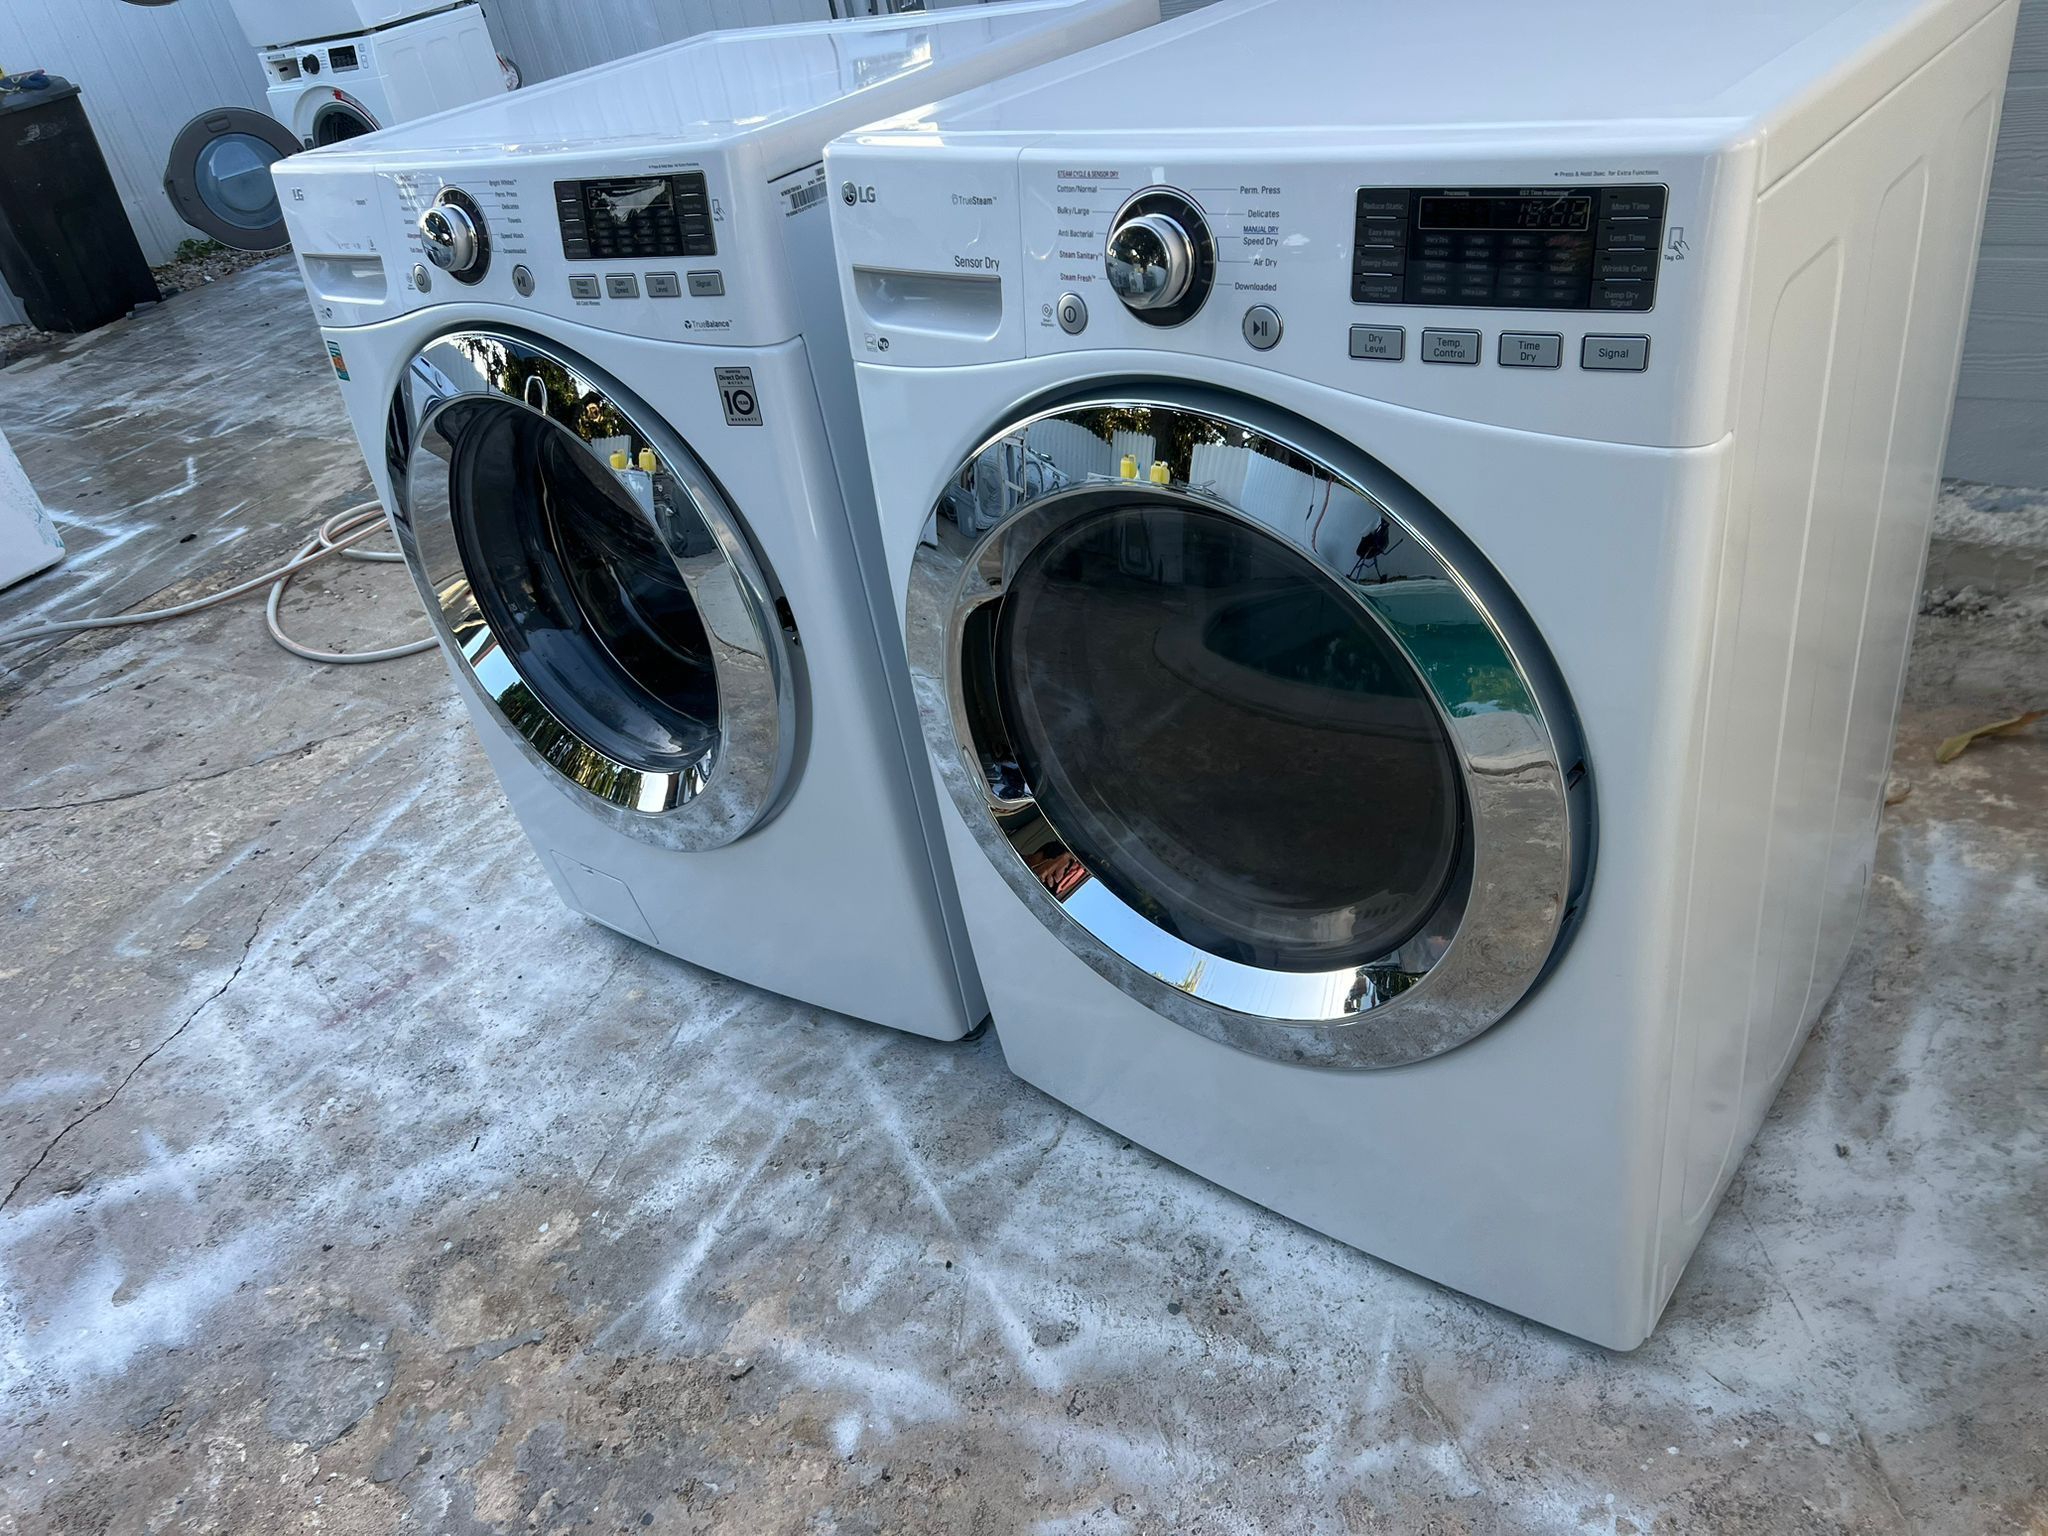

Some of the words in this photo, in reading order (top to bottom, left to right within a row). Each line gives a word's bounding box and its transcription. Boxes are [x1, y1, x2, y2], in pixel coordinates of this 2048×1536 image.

[1057, 185, 1098, 193] Cotton/Normal
[1240, 186, 1259, 194] Perm.
[1261, 186, 1281, 194] Press
[858, 186, 876, 203] LG
[1057, 207, 1090, 216] Bulky/Large
[1248, 209, 1280, 218] Delicates
[1058, 230, 1070, 238] Anti
[1070, 230, 1094, 238] Bacterial
[1244, 225, 1266, 233] MANUAL
[1243, 237, 1264, 246] Speed
[1266, 237, 1278, 247] Dry
[1059, 250, 1076, 258] Steam
[1664, 254, 1674, 262] Tag
[954, 255, 982, 268] Sensor
[985, 256, 1000, 272] Dry
[1254, 258, 1263, 266] Air
[1266, 258, 1278, 268] Dry
[1602, 264, 1629, 272] Wrinkle
[1060, 272, 1076, 281] Steam
[1234, 282, 1277, 292] Downloaded
[1368, 334, 1384, 346] Dry
[1364, 343, 1387, 354] Level
[1518, 341, 1541, 351] Time
[1433, 346, 1466, 358] Control
[1598, 348, 1630, 360] Signal
[1520, 352, 1537, 363] Dry
[724, 390, 754, 415] 10
